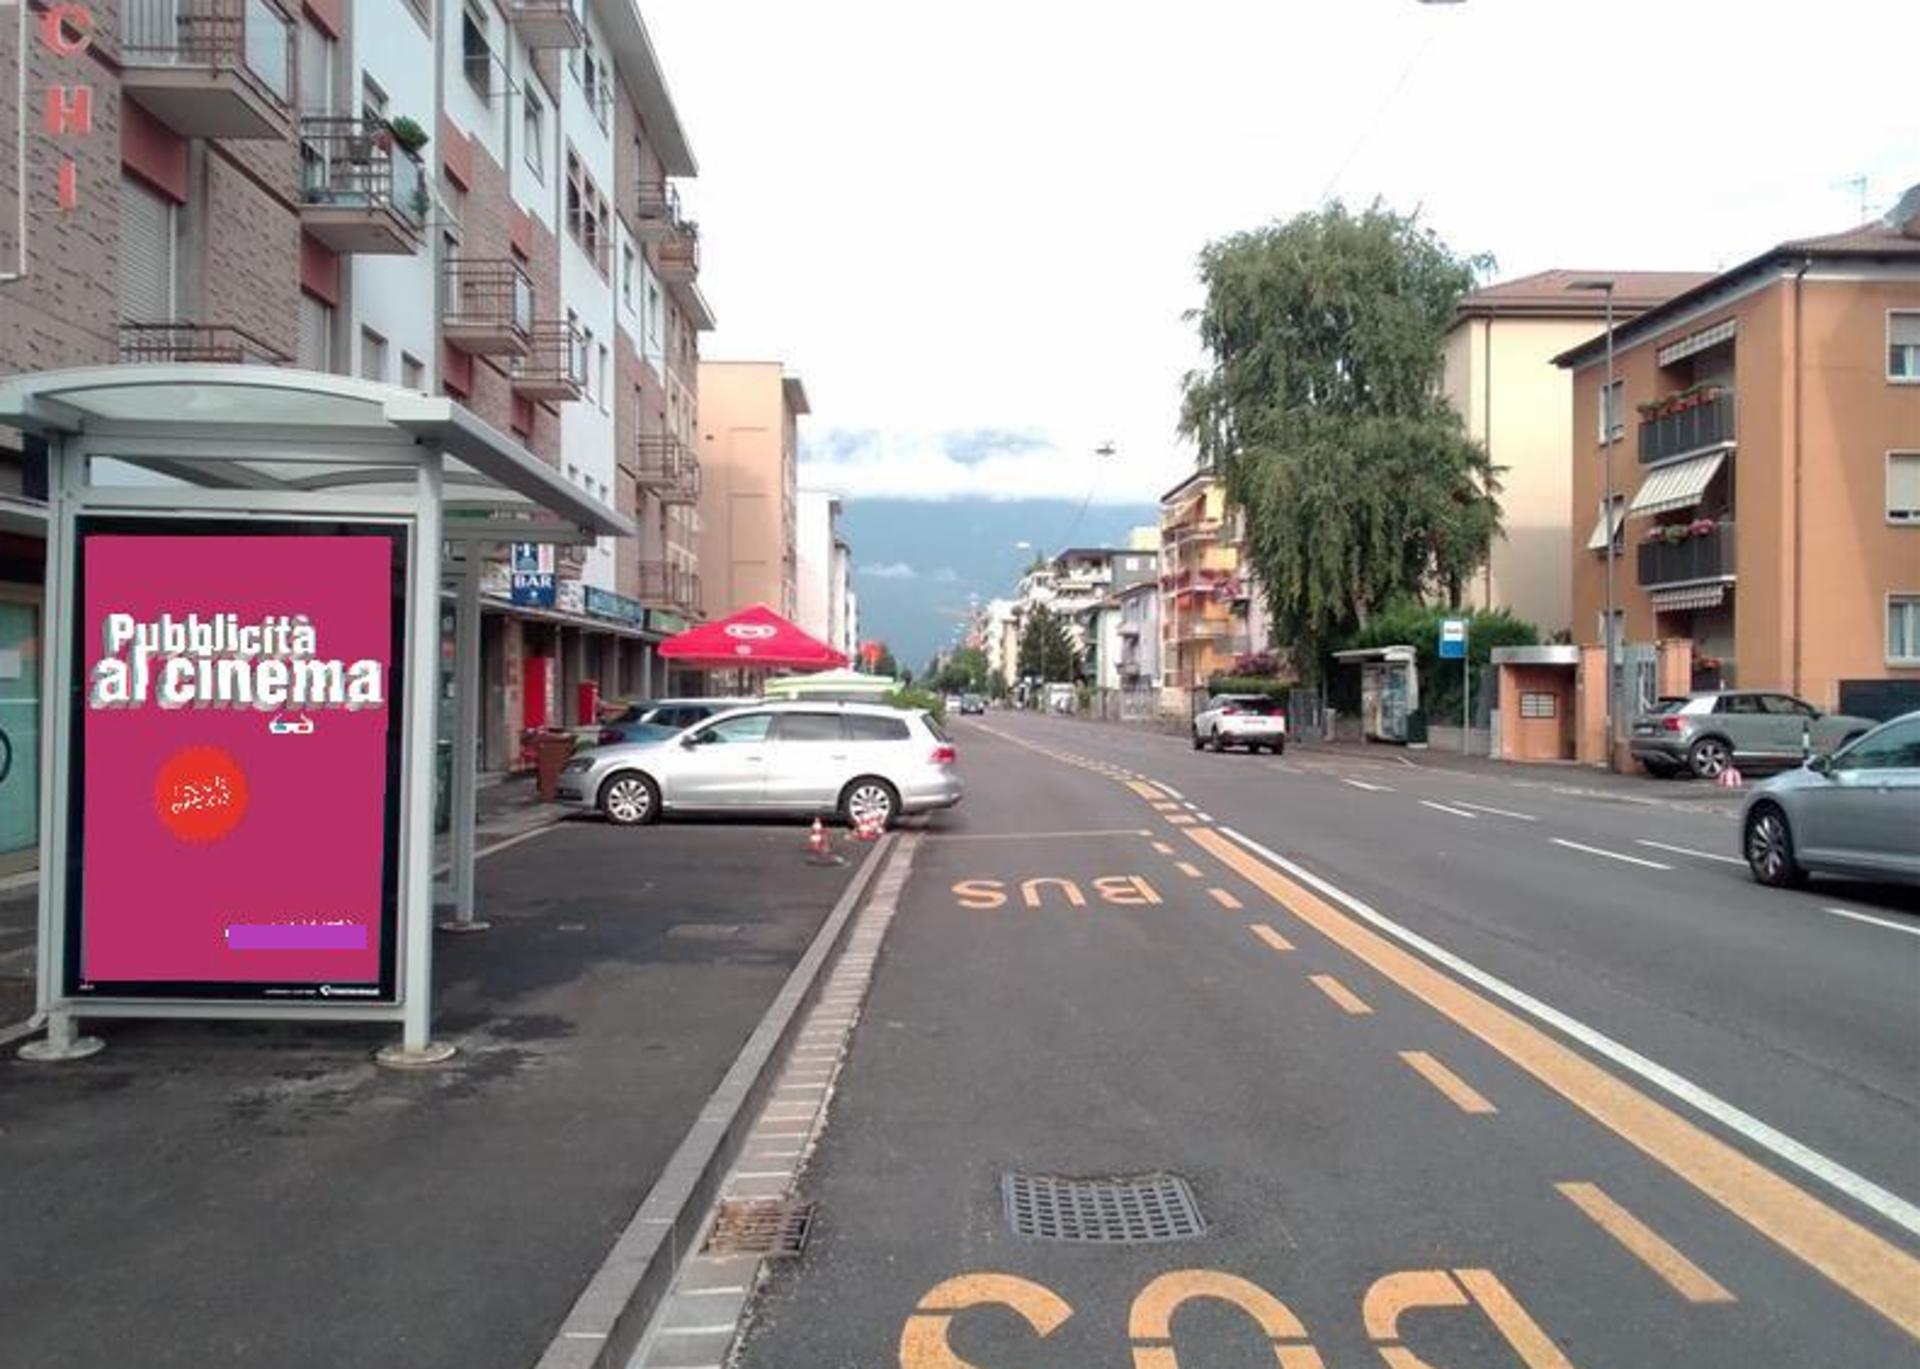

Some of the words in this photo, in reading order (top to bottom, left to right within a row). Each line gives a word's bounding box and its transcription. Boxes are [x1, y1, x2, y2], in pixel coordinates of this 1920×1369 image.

[514, 573, 552, 588] BAR
[105, 613, 316, 656] Pubblicità
[92, 648, 150, 709] al
[160, 654, 384, 710] cinema
[951, 874, 1163, 909] BUS
